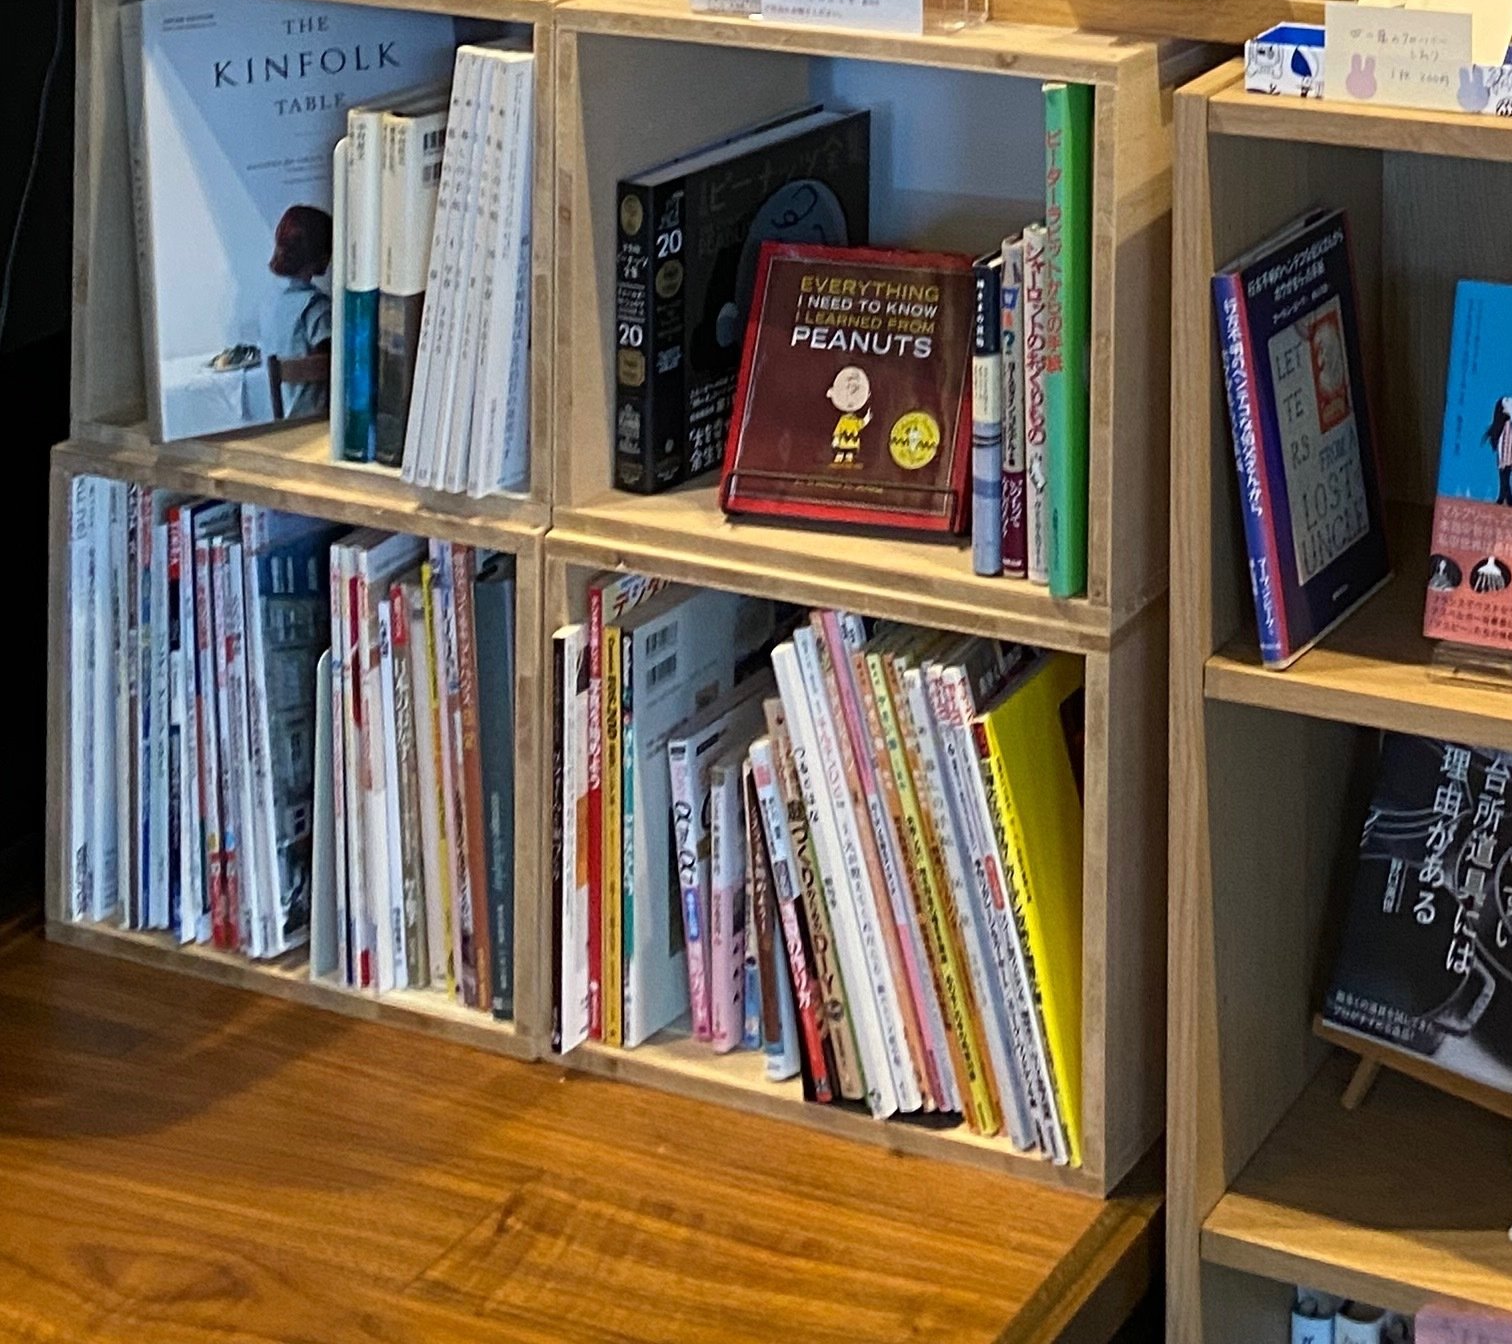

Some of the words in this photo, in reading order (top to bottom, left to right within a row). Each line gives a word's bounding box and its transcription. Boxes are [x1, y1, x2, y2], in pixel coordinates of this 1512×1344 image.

[281, 15, 330, 36] THE
[213, 41, 401, 89] KINFOLK
[273, 92, 348, 117] TABLE
[656, 228, 683, 259] 20
[800, 274, 940, 304] EVERYTHING
[804, 309, 882, 331] LEARNED
[888, 314, 937, 335] FROM
[806, 295, 853, 314] NEED
[859, 298, 882, 315] TO
[886, 301, 939, 321] KNOW
[619, 323, 643, 347] 20
[790, 326, 934, 360] PEANUTS
[1411, 744, 1473, 926] 理由がある
[1445, 757, 1509, 975] 台所道具には
